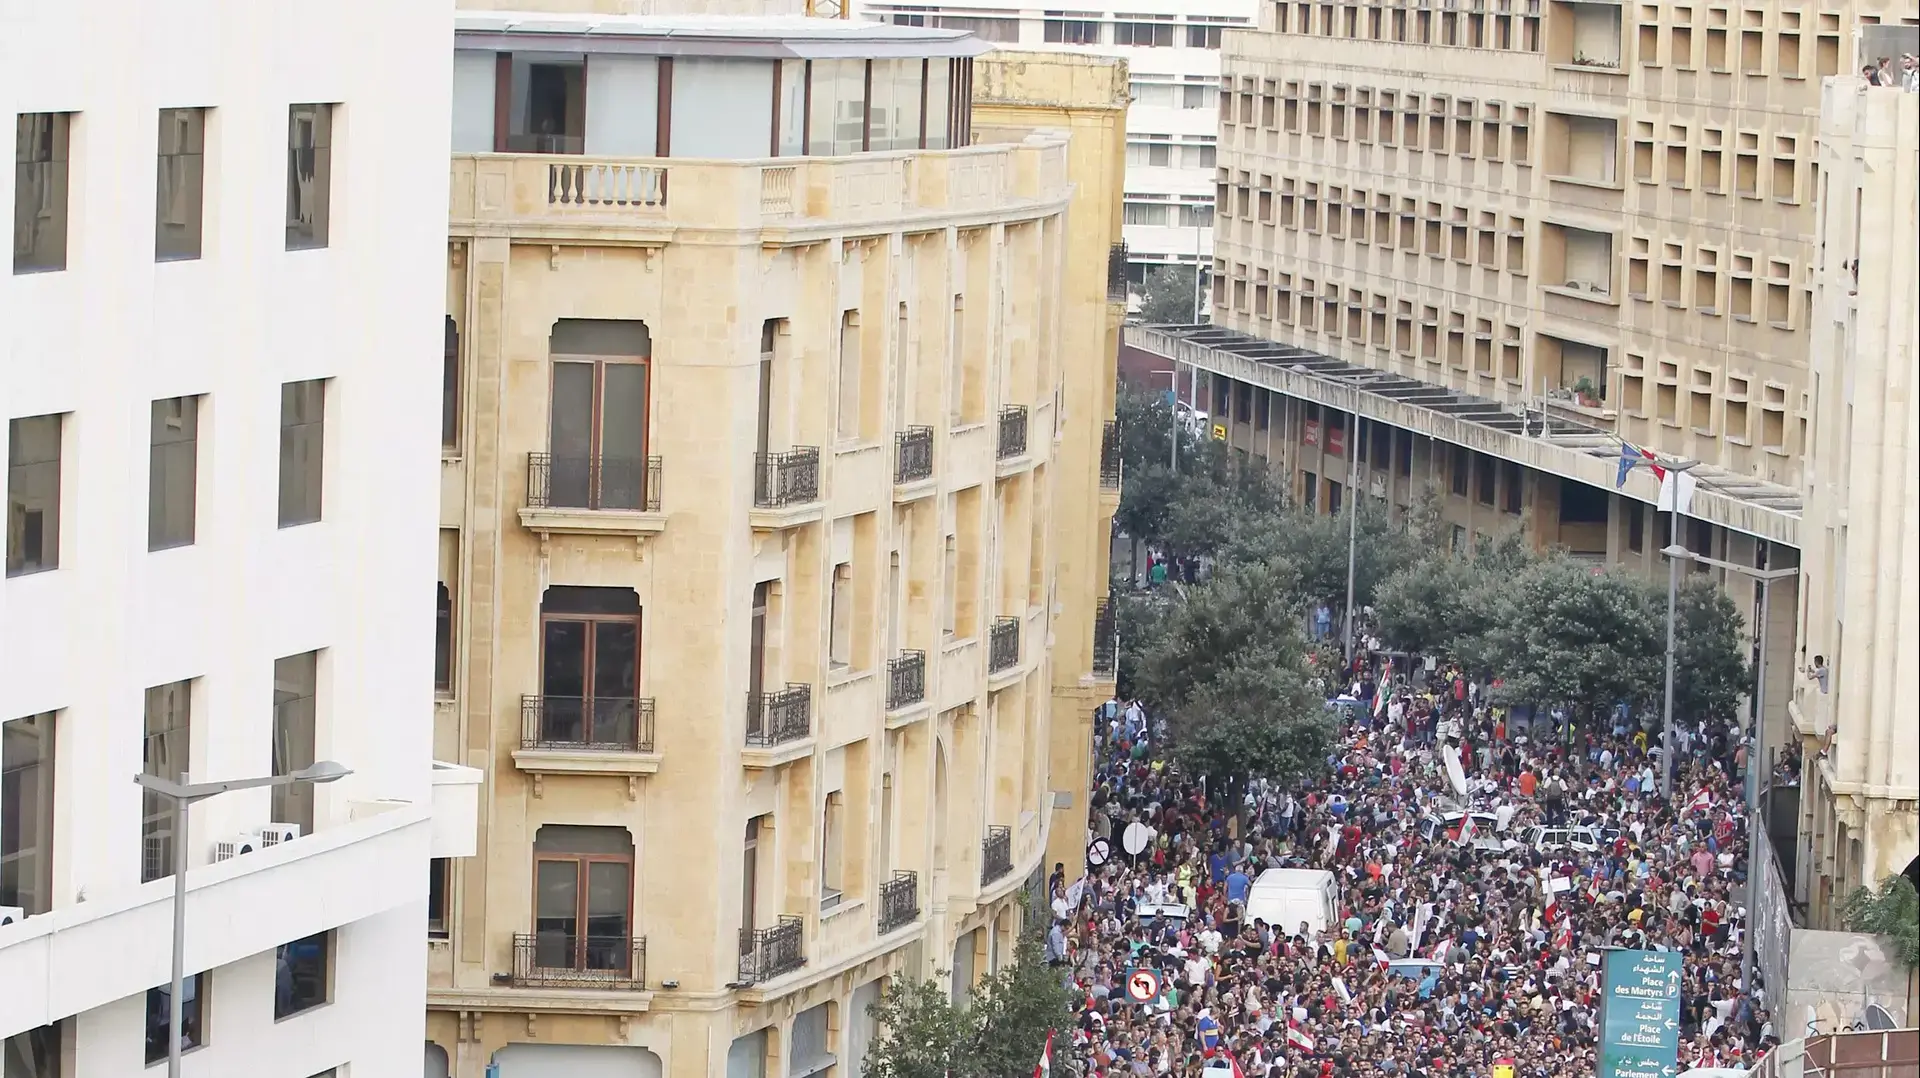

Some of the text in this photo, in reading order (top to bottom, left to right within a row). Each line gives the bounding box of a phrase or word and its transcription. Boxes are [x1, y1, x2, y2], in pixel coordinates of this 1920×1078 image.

[1643, 954, 1665, 963] ساحة
[1632, 964, 1665, 975] الشهداء
[1642, 977, 1664, 987] Place
[1614, 984, 1663, 998] des Martyrs
[1635, 1011, 1662, 1022] النجمة
[1640, 1024, 1661, 1034] Place
[1621, 1032, 1632, 1042] de
[1615, 1068, 1659, 1078] Parlement
